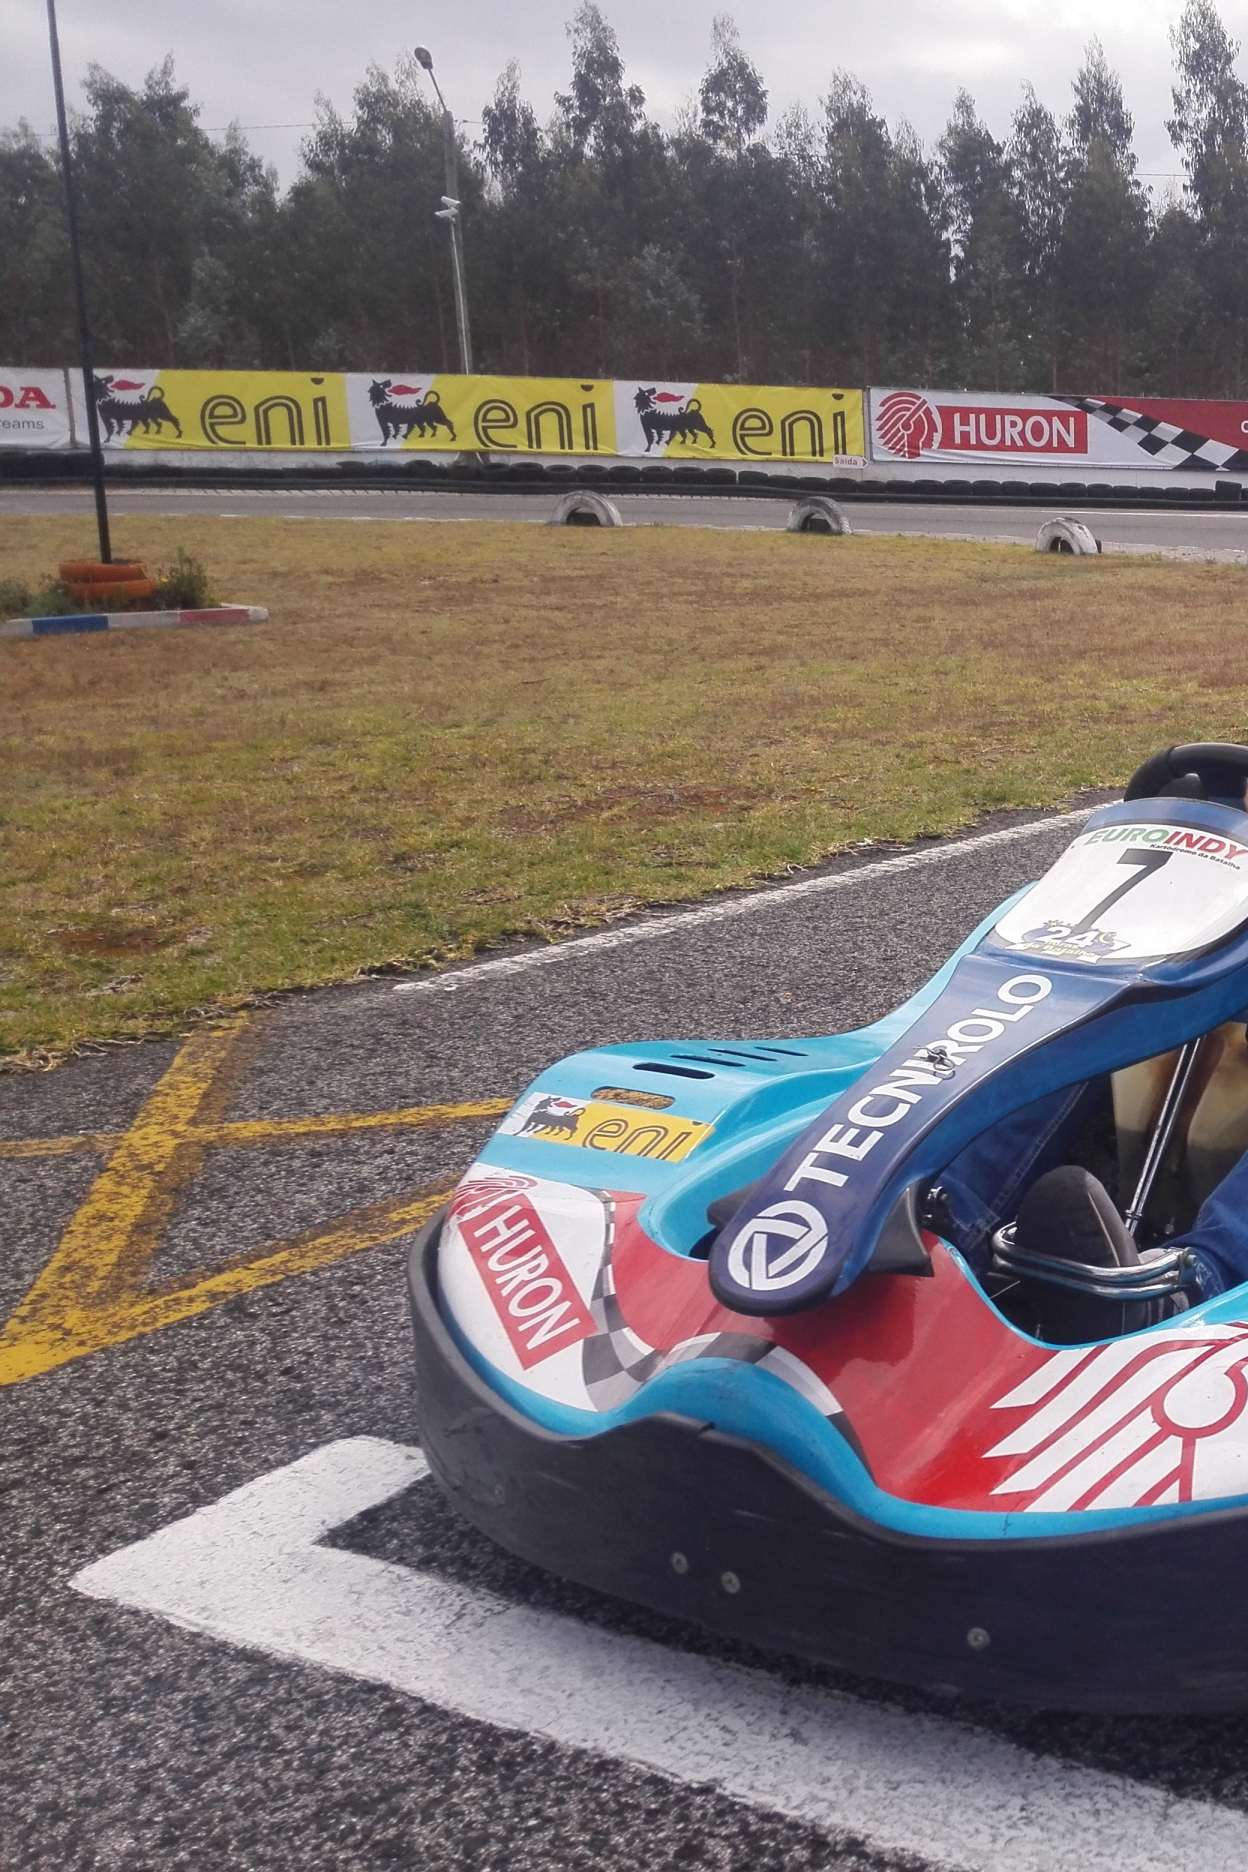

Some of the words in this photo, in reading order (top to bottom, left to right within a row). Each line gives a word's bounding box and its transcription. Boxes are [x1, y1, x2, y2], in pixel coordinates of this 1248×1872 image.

[201, 377, 332, 447] eni
[474, 383, 599, 451] eni
[733, 392, 847, 457] eni
[953, 412, 1076, 449] HURON
[1077, 848, 1174, 931] 7
[1209, 855, 1241, 871] Batalha
[1030, 926, 1100, 949] 24
[783, 974, 1055, 1193] TECNIROLO
[582, 1118, 702, 1162] eni
[472, 1204, 582, 1352] HURON
